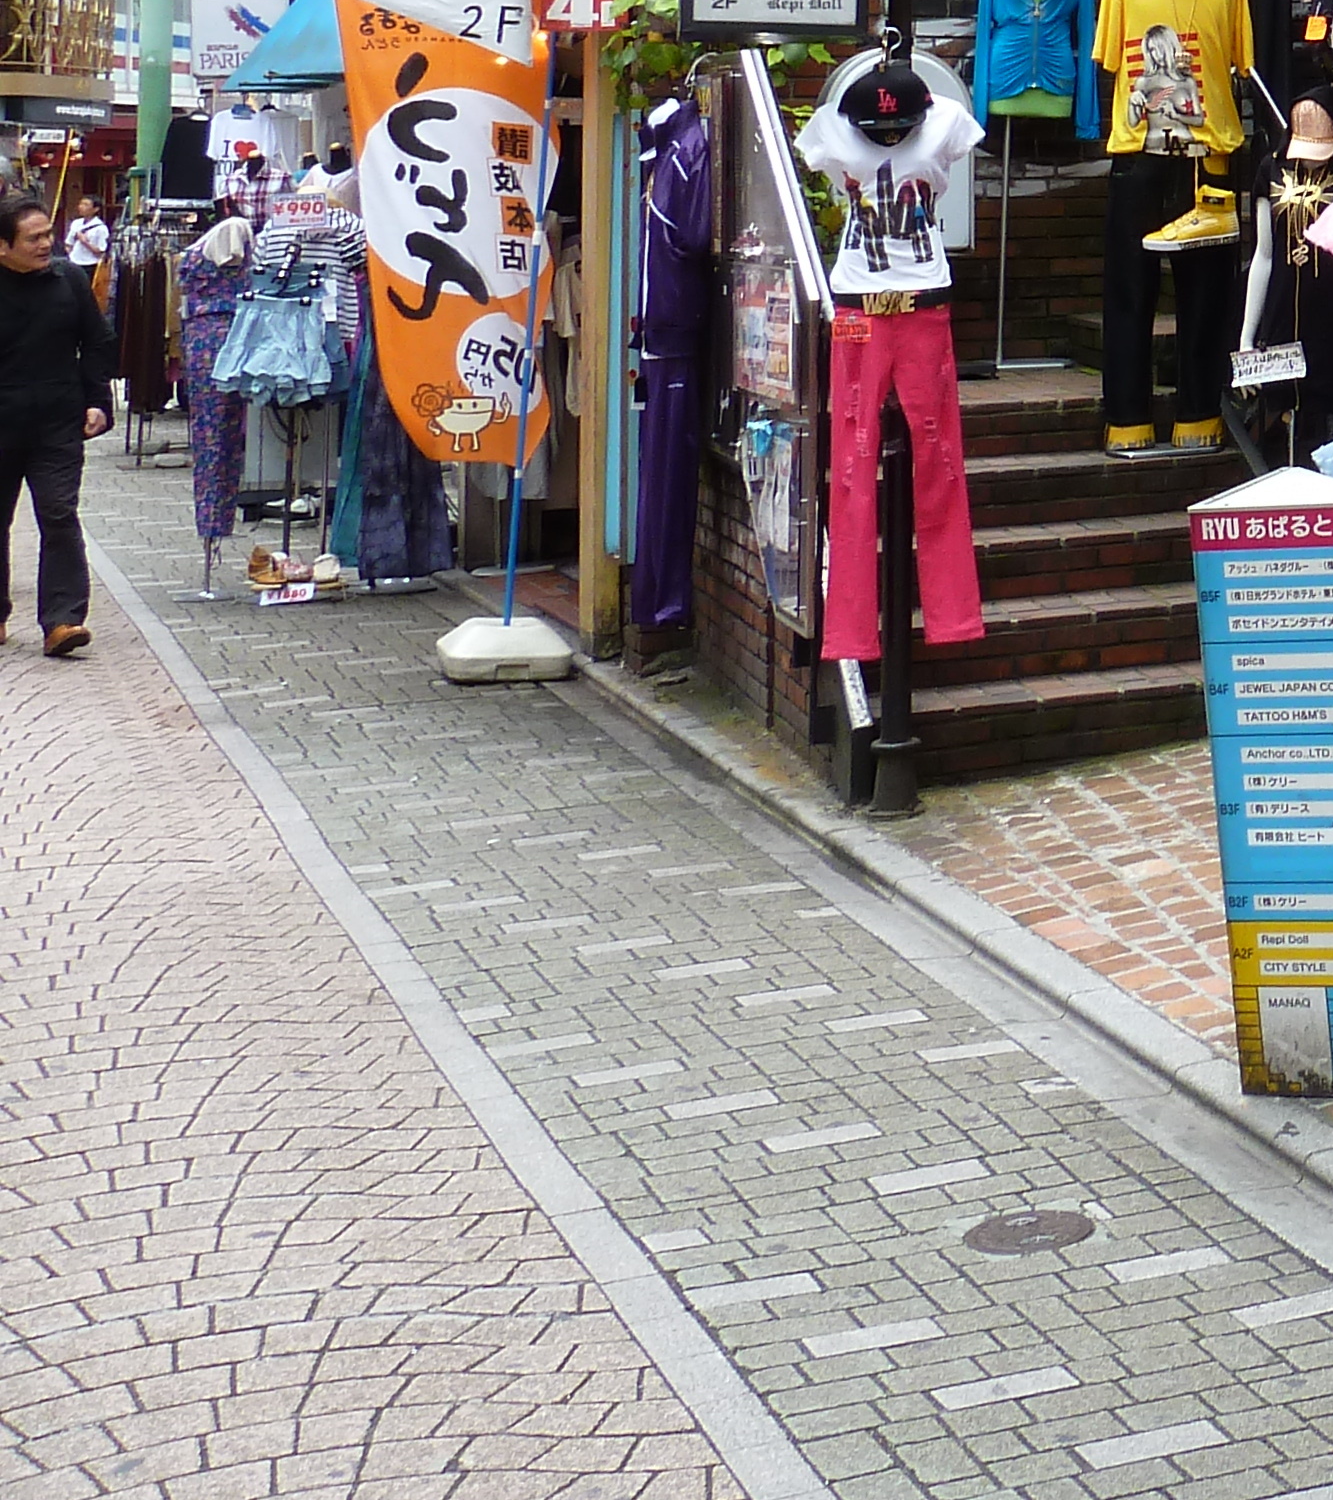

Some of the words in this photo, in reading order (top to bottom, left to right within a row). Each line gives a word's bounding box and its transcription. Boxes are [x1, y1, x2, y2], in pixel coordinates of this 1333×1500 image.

[272, 201, 324, 217] ¥990
[1201, 516, 1241, 541] RYU
[1236, 656, 1266, 668] spica
[1239, 681, 1277, 694] JEWEL
[1278, 680, 1317, 693] JAPAN
[1243, 711, 1290, 723] TATTOO
[1246, 747, 1286, 760] Anchor
[1261, 933, 1286, 946] Repi
[1288, 933, 1310, 945] Doll
[1264, 961, 1290, 973] CITY
[1291, 961, 1327, 973] STYLE
